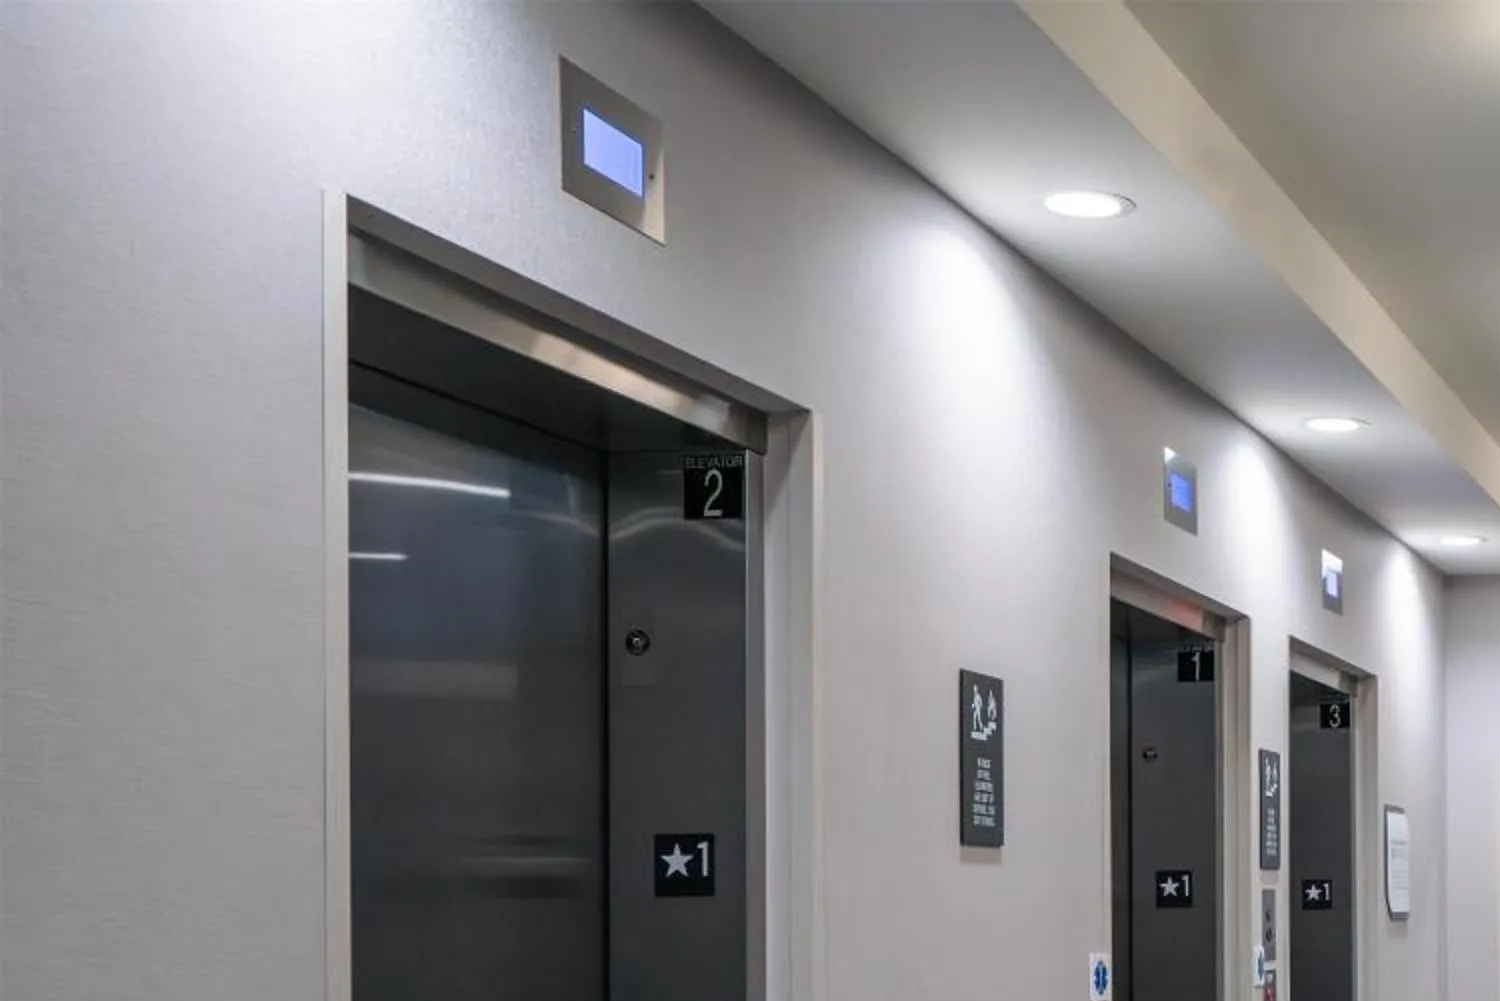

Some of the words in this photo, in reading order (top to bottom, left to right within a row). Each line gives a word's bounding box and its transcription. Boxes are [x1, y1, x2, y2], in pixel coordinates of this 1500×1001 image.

[685, 456, 743, 469] ELEVATOR
[704, 469, 723, 516] 2
[1191, 651, 1200, 681] 1
[1330, 704, 1340, 728] 3
[697, 841, 709, 876] 1
